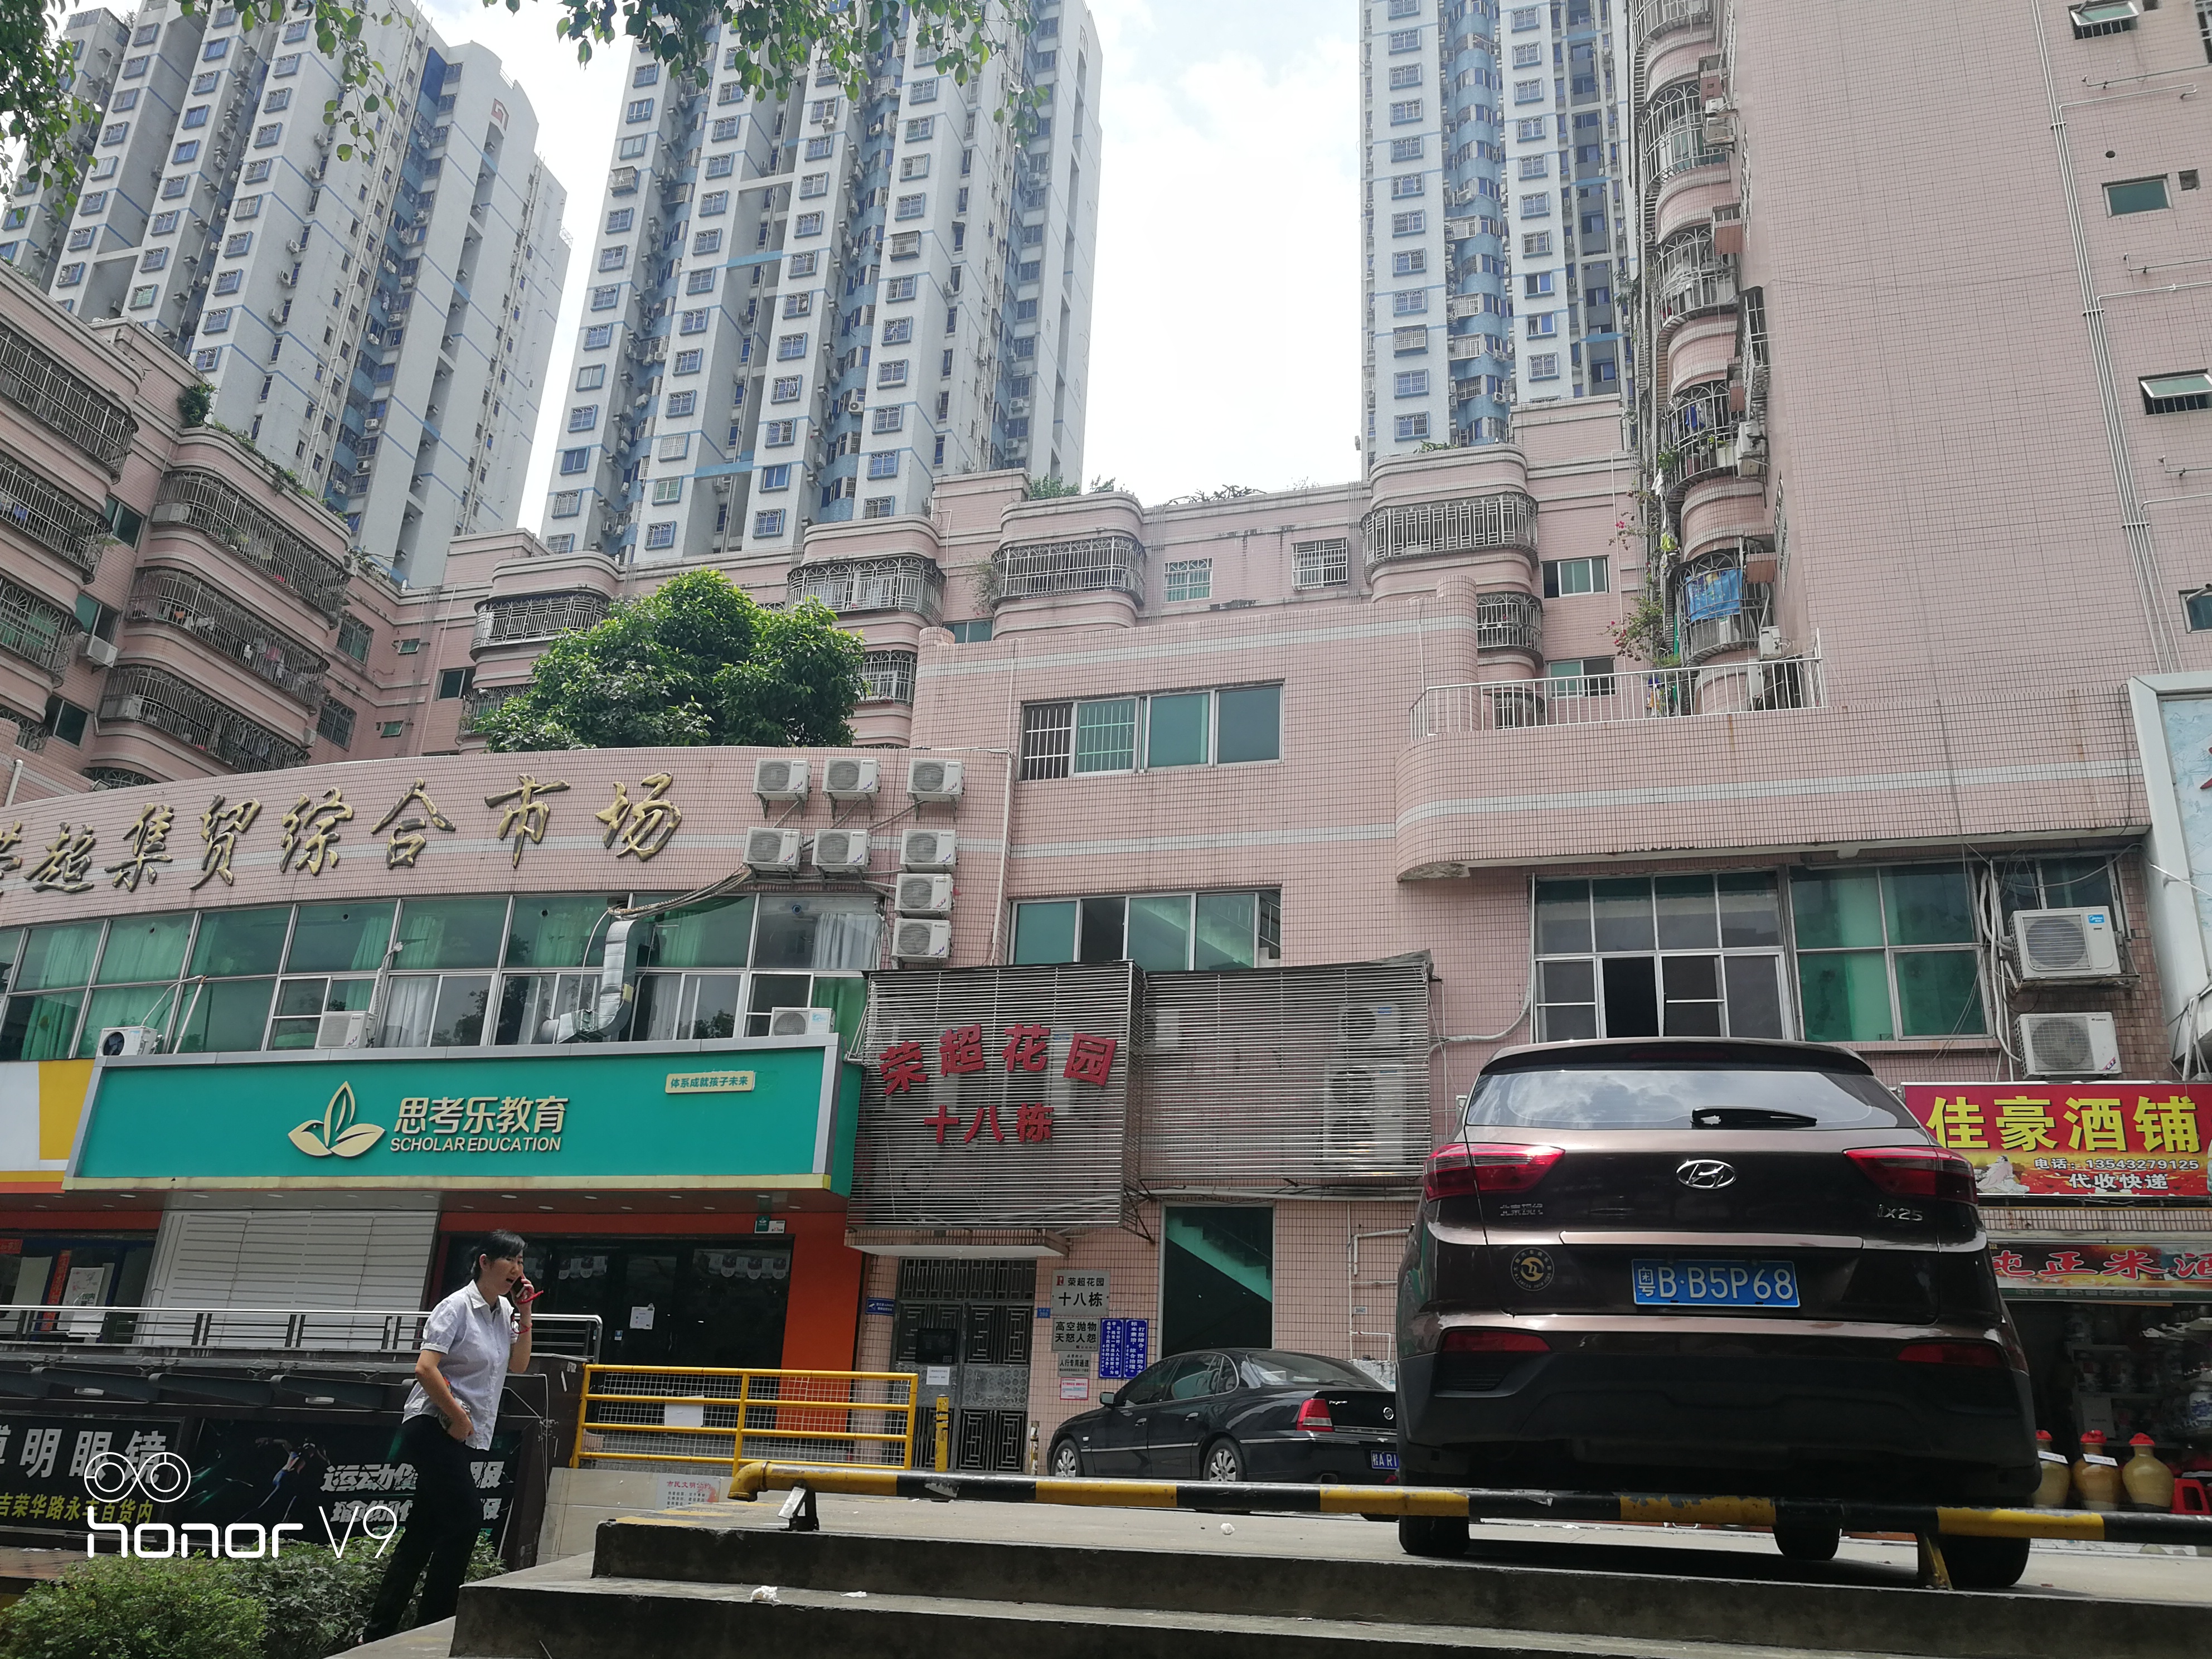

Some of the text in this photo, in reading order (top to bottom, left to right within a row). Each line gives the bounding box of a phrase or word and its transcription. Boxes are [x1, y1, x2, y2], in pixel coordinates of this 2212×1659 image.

[879, 1023, 1117, 1096] 荣超花园
[671, 1076, 748, 1088] 体系成就孩子未来
[394, 1095, 569, 1134] 思考乐教育
[924, 1103, 1054, 1143] 十八栋
[1926, 1095, 2200, 1153] 佳豪酒铺
[2069, 1173, 2169, 1190] 代收快递
[1068, 1277, 1104, 1287] 荣超花园
[1638, 1267, 1793, 1299] 粤B·B5P68
[1058, 1292, 1103, 1307] 十八栋
[1055, 1322, 1097, 1331] 高空抛物
[1055, 1333, 1097, 1343] 天怒人怨
[1059, 1359, 1089, 1367] 人行专用通道
[667, 1481, 711, 1490] 市民文明公约
